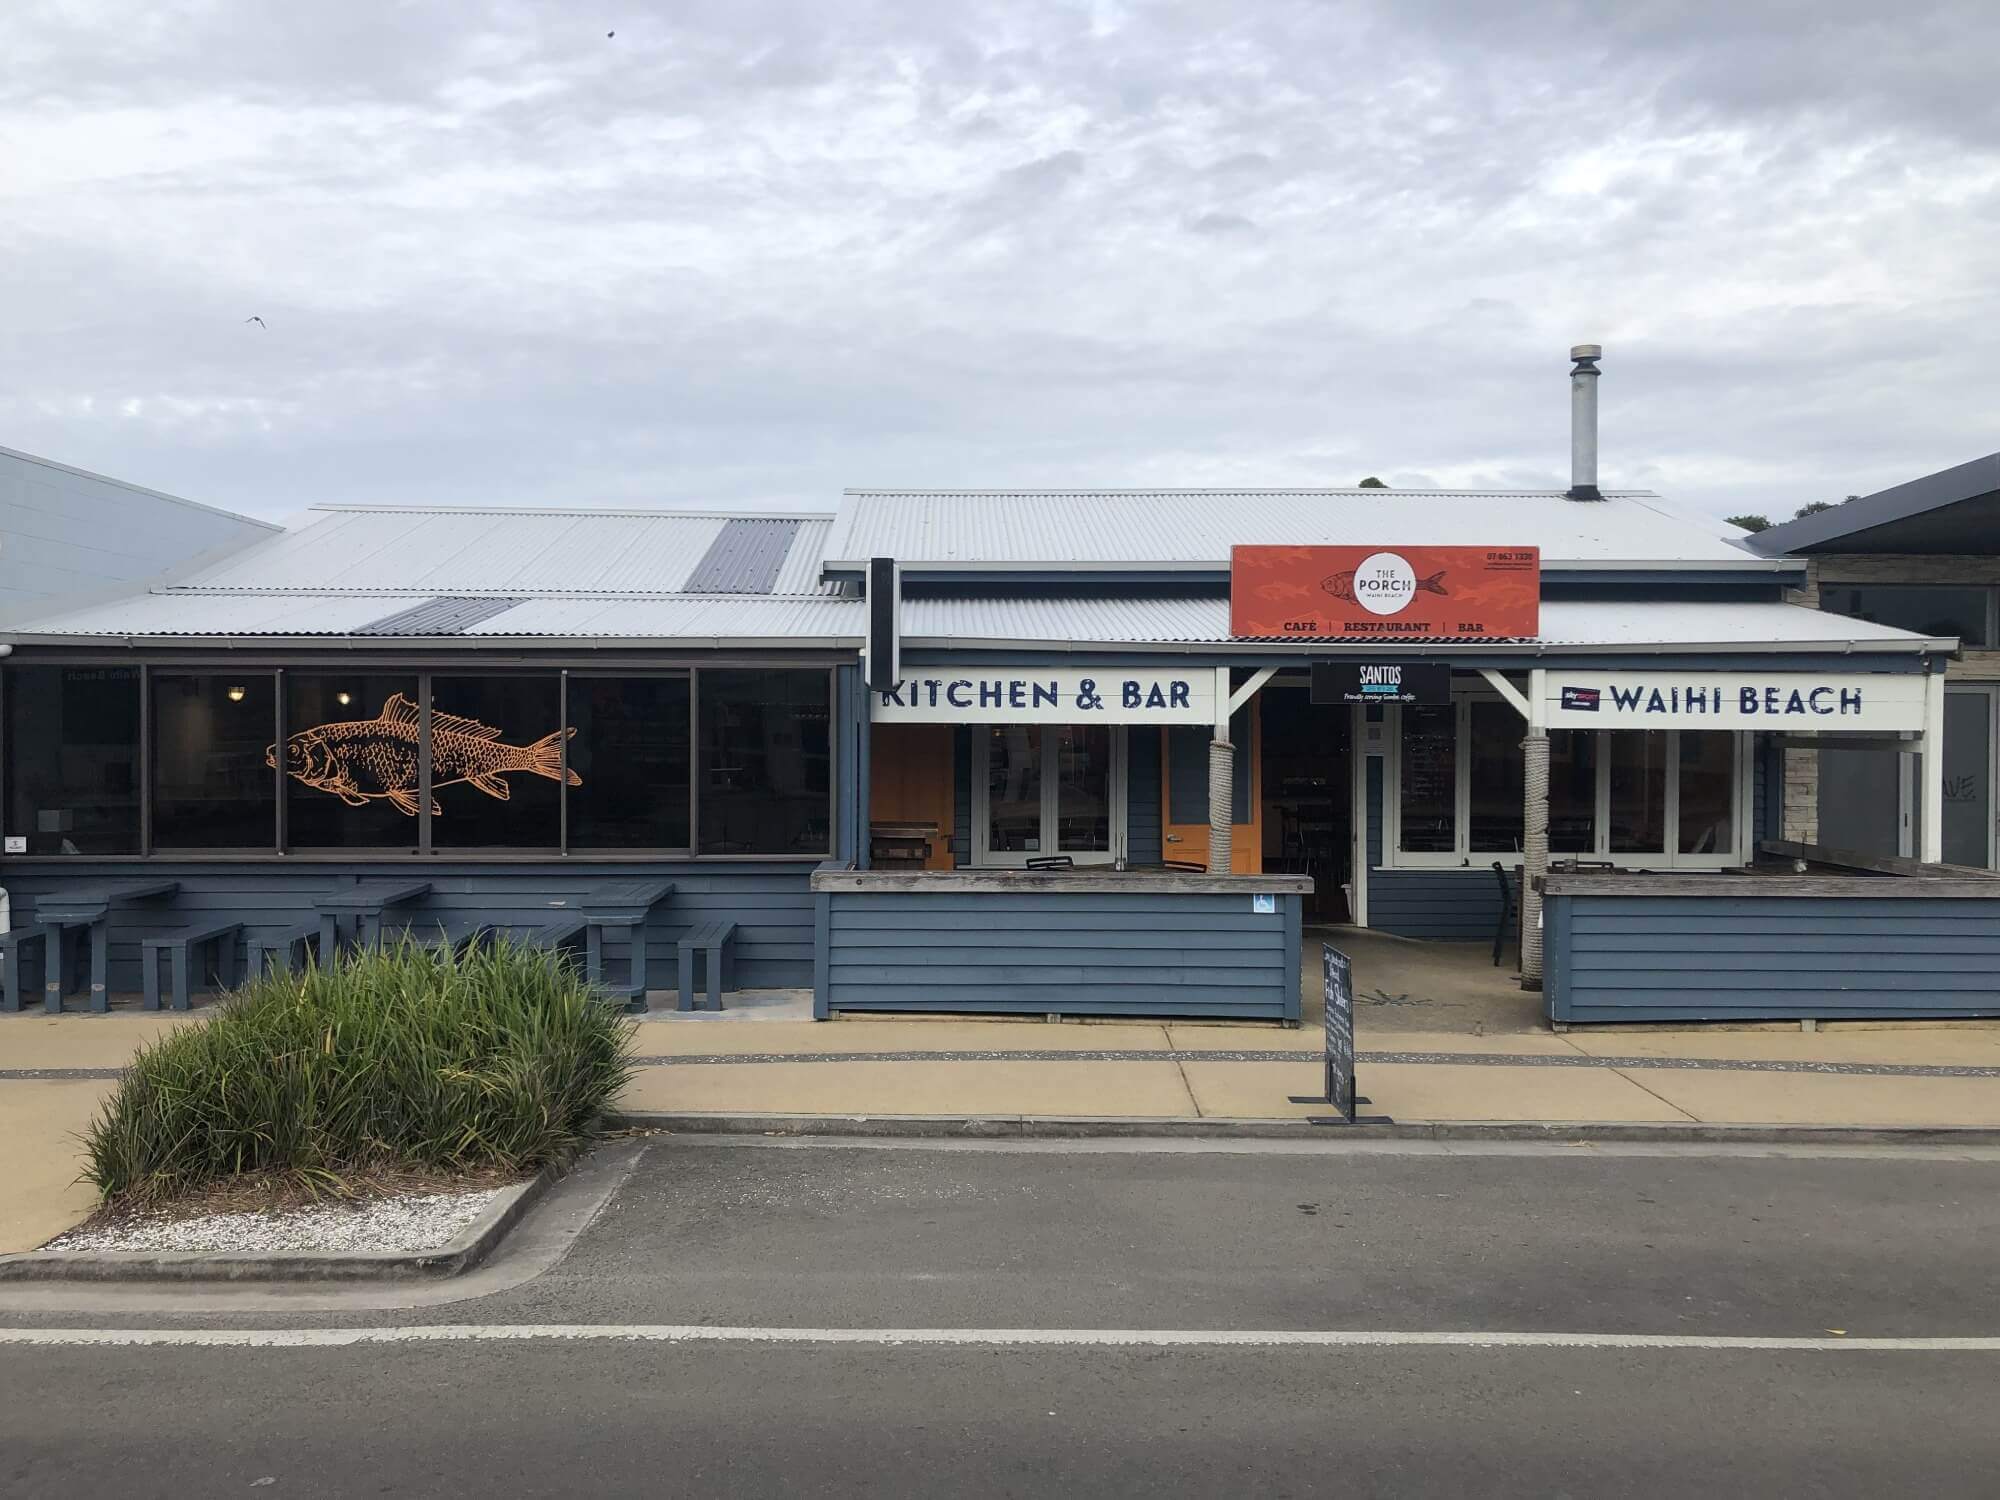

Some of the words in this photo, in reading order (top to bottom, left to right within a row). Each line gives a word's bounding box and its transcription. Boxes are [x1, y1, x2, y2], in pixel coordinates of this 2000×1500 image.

[1376, 569, 1395, 579] THE
[1359, 579, 1411, 591] PORCH
[1284, 619, 1317, 632] CAFÉ
[1344, 622, 1431, 632] RESTAURANT
[1458, 623, 1484, 633] BAR
[1359, 665, 1402, 685] SANTOS
[882, 679, 1058, 709] KITCHEN
[1076, 678, 1104, 710] &
[1122, 680, 1191, 709] BAR
[1609, 685, 1721, 714] WAIHI
[1739, 686, 1862, 715] BEACH
